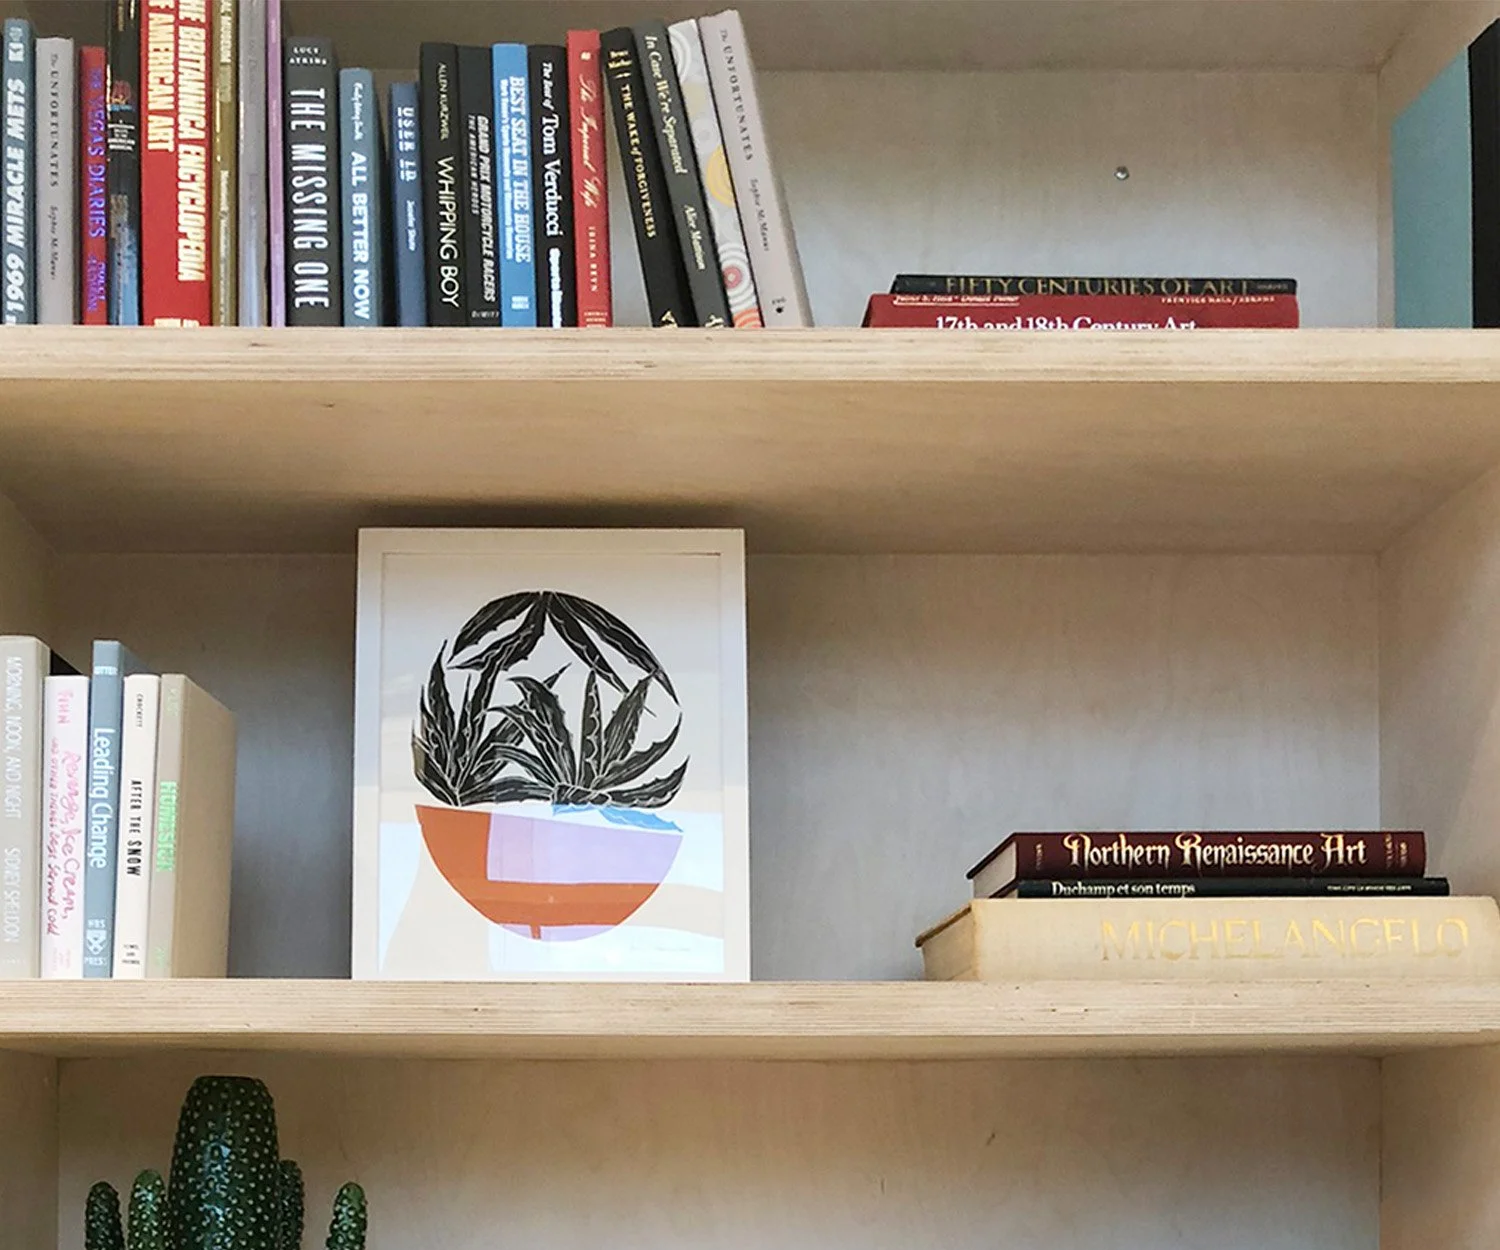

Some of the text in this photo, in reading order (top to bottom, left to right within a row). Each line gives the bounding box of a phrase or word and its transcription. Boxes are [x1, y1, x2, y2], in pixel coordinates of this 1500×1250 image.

[8, 78, 26, 140] METS
[50, 70, 59, 188] UNFORTUNATES
[148, 12, 175, 153] AMERICAN ART
[402, 106, 416, 152] USER
[438, 63, 449, 140] ALLEN KURZWEIL
[644, 34, 688, 175] In Case We're Separated
[724, 46, 753, 162] UNFORTUNATES
[88, 95, 105, 238] VEGAS DIARIES
[178, 25, 206, 282] BRITANNICA ENCYCLOPEDIA
[468, 133, 478, 178] AMERICAN
[477, 115, 490, 153] GRAND
[480, 155, 492, 182] PRIX
[509, 76, 531, 263] BEST SEAT IN THE HOUSE
[541, 62, 563, 236] The Best of Tom Verducci
[577, 74, 600, 208] The Imperial Wife
[620, 84, 656, 238] THE WAKE FORGIVENESS
[6, 146, 26, 248] MIRACLE
[291, 88, 329, 309] THE MISSING ONE
[351, 151, 370, 320] ALL BETTER NOW
[438, 156, 460, 309] WHIPPING BOY
[480, 184, 494, 257] MOTORCYCLE
[683, 205, 698, 228] Alice
[6, 252, 26, 312] 1969
[483, 259, 496, 302] RACERS
[946, 278, 1250, 295] FIFTY CENTURIES OF ART
[5, 757, 21, 819] AND NIGHT
[89, 727, 115, 869] Leading Change
[127, 780, 143, 877] AFTER THE SNOW
[156, 780, 178, 873] HOMESICK
[62, 829, 82, 856] Ice
[1051, 881, 1196, 898] Duchamp et son temps
[1063, 833, 1170, 872] Northern
[1174, 832, 1314, 874] Renaissance
[1320, 833, 1368, 873] Art
[4, 846, 21, 943] SIDNEY SHELDON
[1102, 916, 1470, 961] MICHELANGELO
